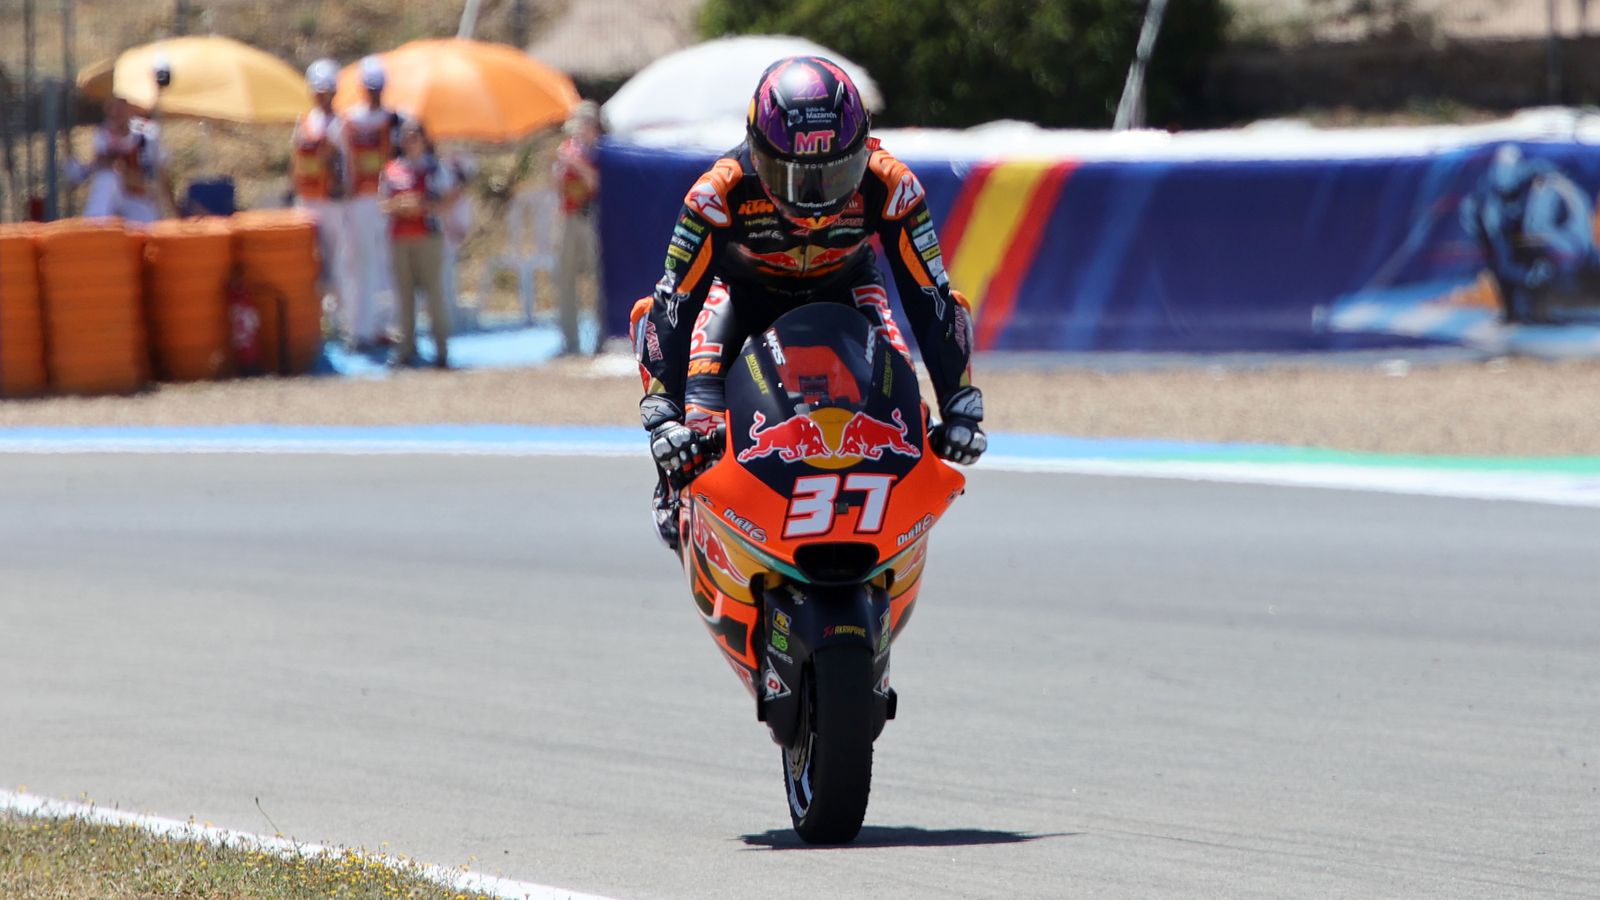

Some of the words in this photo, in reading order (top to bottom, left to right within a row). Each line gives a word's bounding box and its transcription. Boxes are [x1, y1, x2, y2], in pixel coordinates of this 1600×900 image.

[794, 130, 836, 154] MT
[738, 199, 774, 215] KTM
[783, 474, 897, 538] 37
